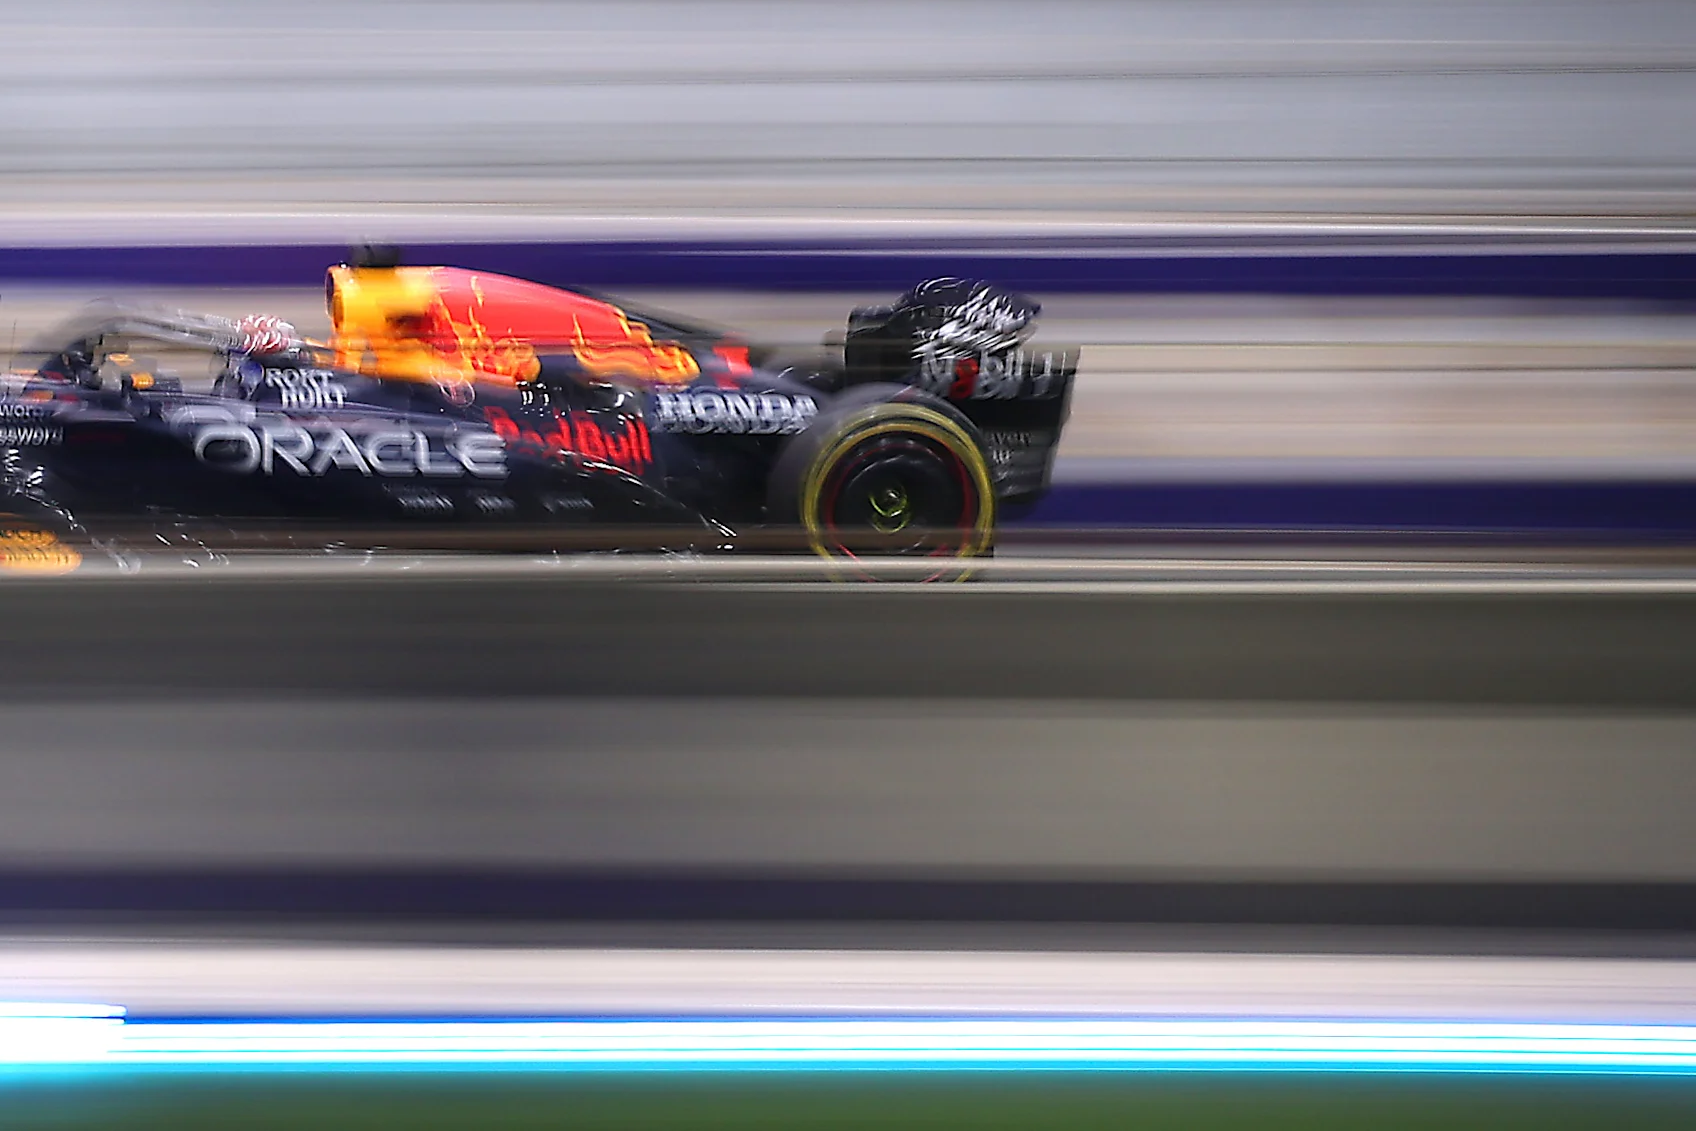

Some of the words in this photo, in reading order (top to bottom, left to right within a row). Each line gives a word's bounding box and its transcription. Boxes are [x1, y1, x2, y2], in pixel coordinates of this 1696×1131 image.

[654, 391, 818, 434] HONDA
[194, 424, 510, 478] ORACLE
[570, 412, 653, 474] Bull
